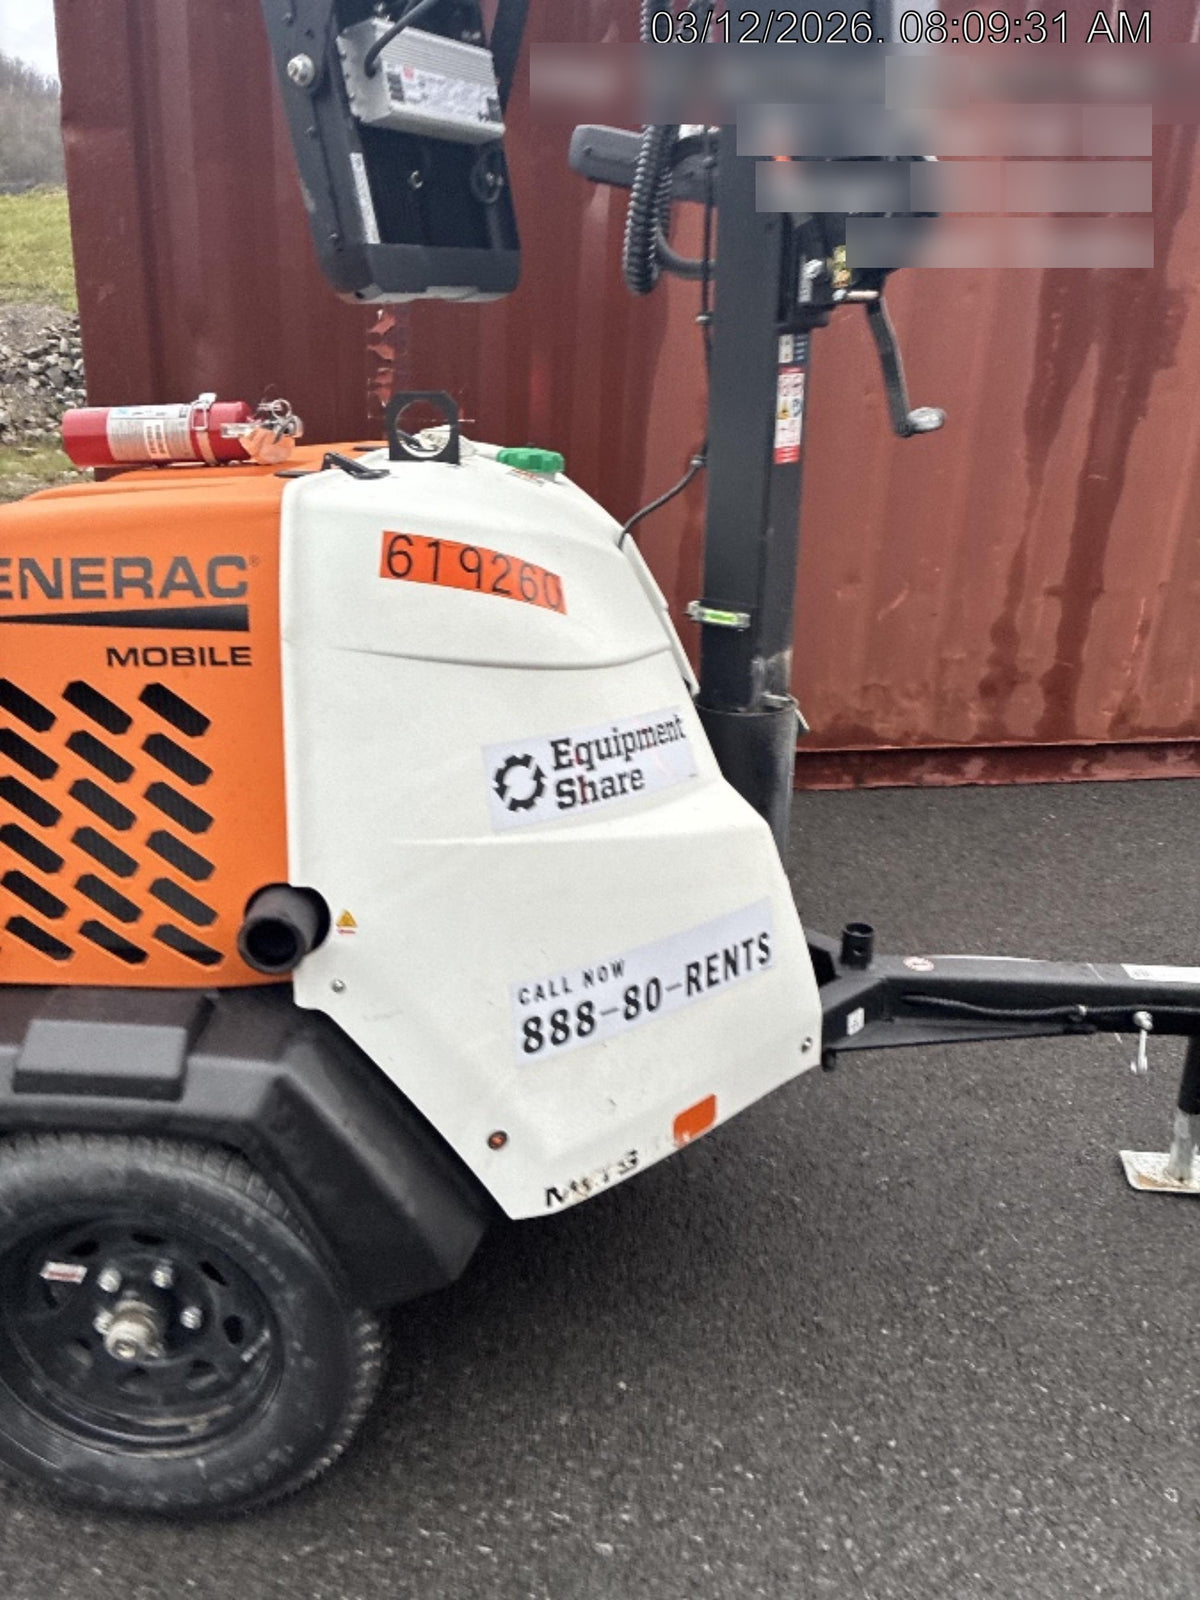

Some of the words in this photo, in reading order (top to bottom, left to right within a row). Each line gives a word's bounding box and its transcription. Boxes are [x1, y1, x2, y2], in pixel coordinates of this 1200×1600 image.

[386, 533, 563, 611] 619260
[106, 646, 252, 668] MOBILE
[550, 714, 687, 771] Equipment
[555, 767, 645, 810] Share
[518, 975, 573, 1006] CALL
[582, 959, 626, 989] NOW
[522, 931, 773, 1055] 888-80-RENTS
